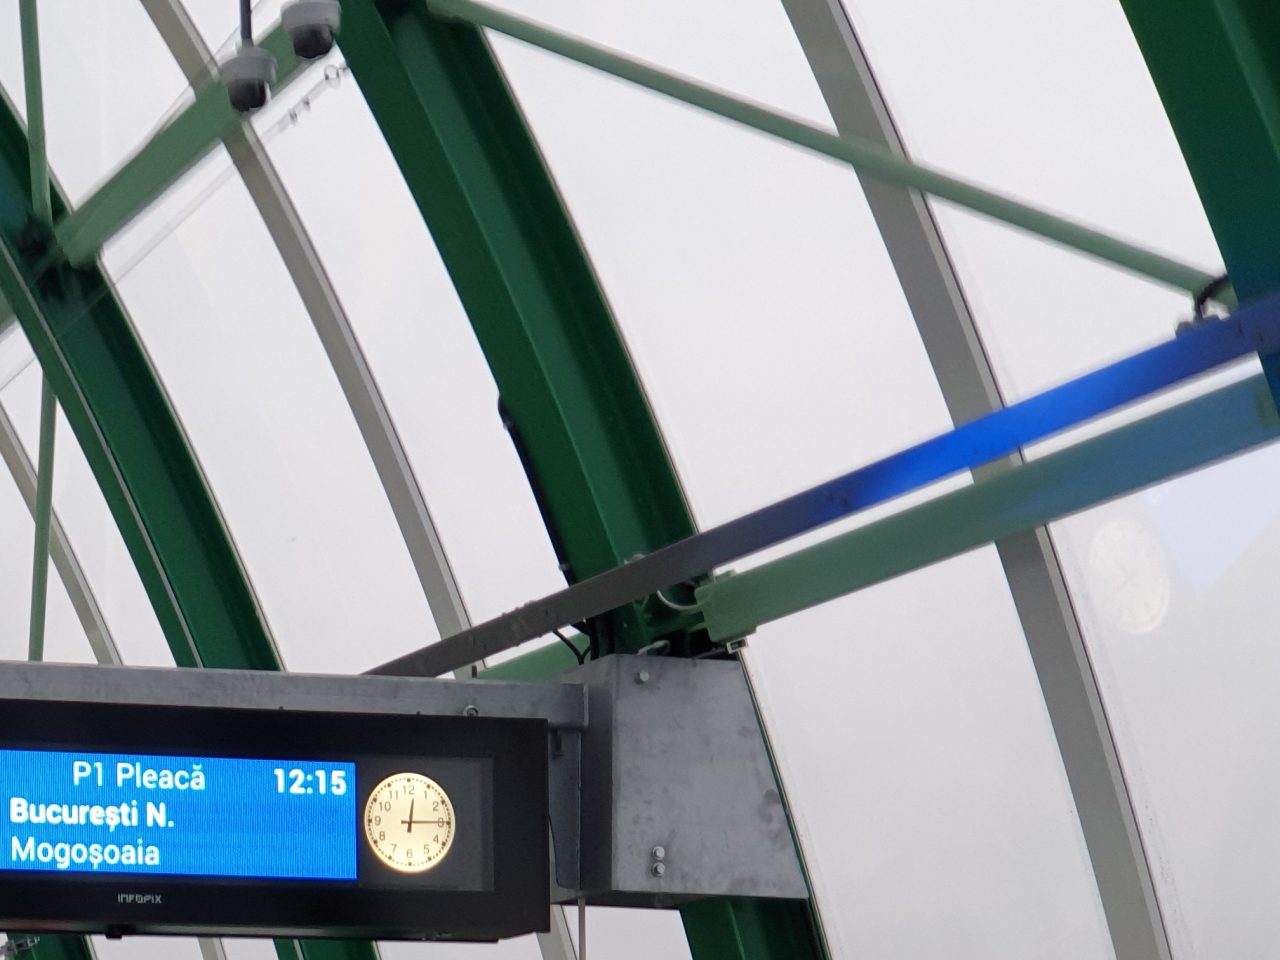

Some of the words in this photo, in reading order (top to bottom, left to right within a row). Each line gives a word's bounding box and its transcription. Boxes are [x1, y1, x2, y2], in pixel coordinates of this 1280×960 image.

[73, 761, 103, 786] P1
[116, 762, 206, 790] Pleacă
[274, 768, 346, 795] 12:15
[403, 785, 415, 795] 12
[378, 801, 391, 812] 10
[432, 801, 439, 812] 2
[10, 797, 138, 832] București
[146, 801, 175, 827] N.
[374, 815, 381, 826] 9
[379, 831, 386, 841] 8
[433, 834, 439, 844] 4
[11, 836, 160, 870] Mogoșoaia
[391, 843, 398, 853] 7
[423, 844, 430, 854] 5
[406, 849, 413, 858] 6
